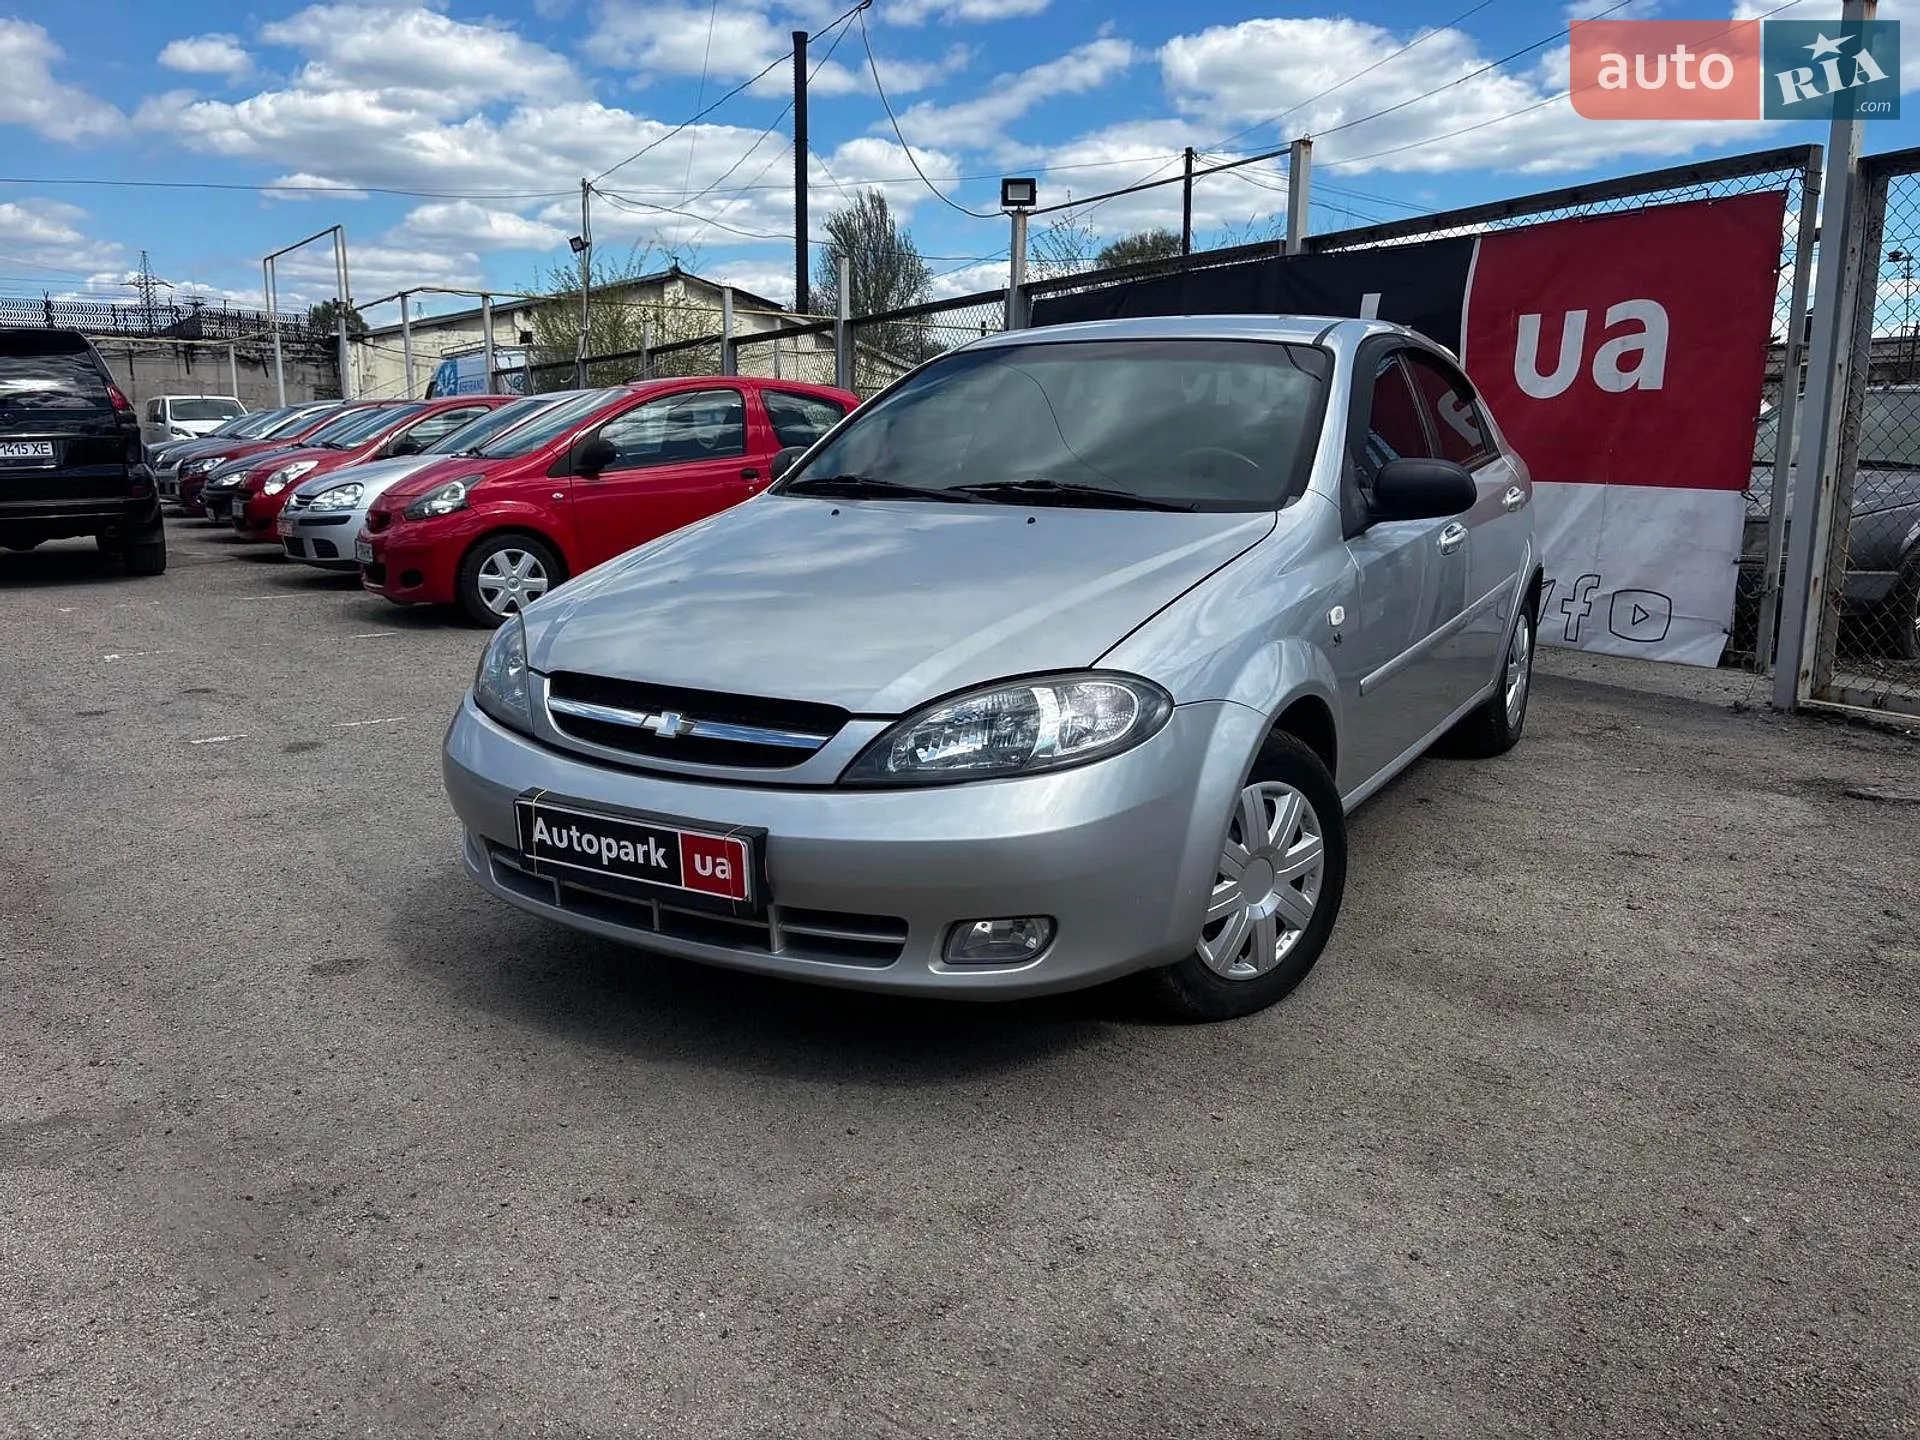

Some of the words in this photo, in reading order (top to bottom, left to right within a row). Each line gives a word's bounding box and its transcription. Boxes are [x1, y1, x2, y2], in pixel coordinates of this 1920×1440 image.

[1513, 298, 1670, 400] ua
[31, 443, 51, 455] XE
[532, 816, 669, 869] Autopark
[693, 852, 733, 880] ua
